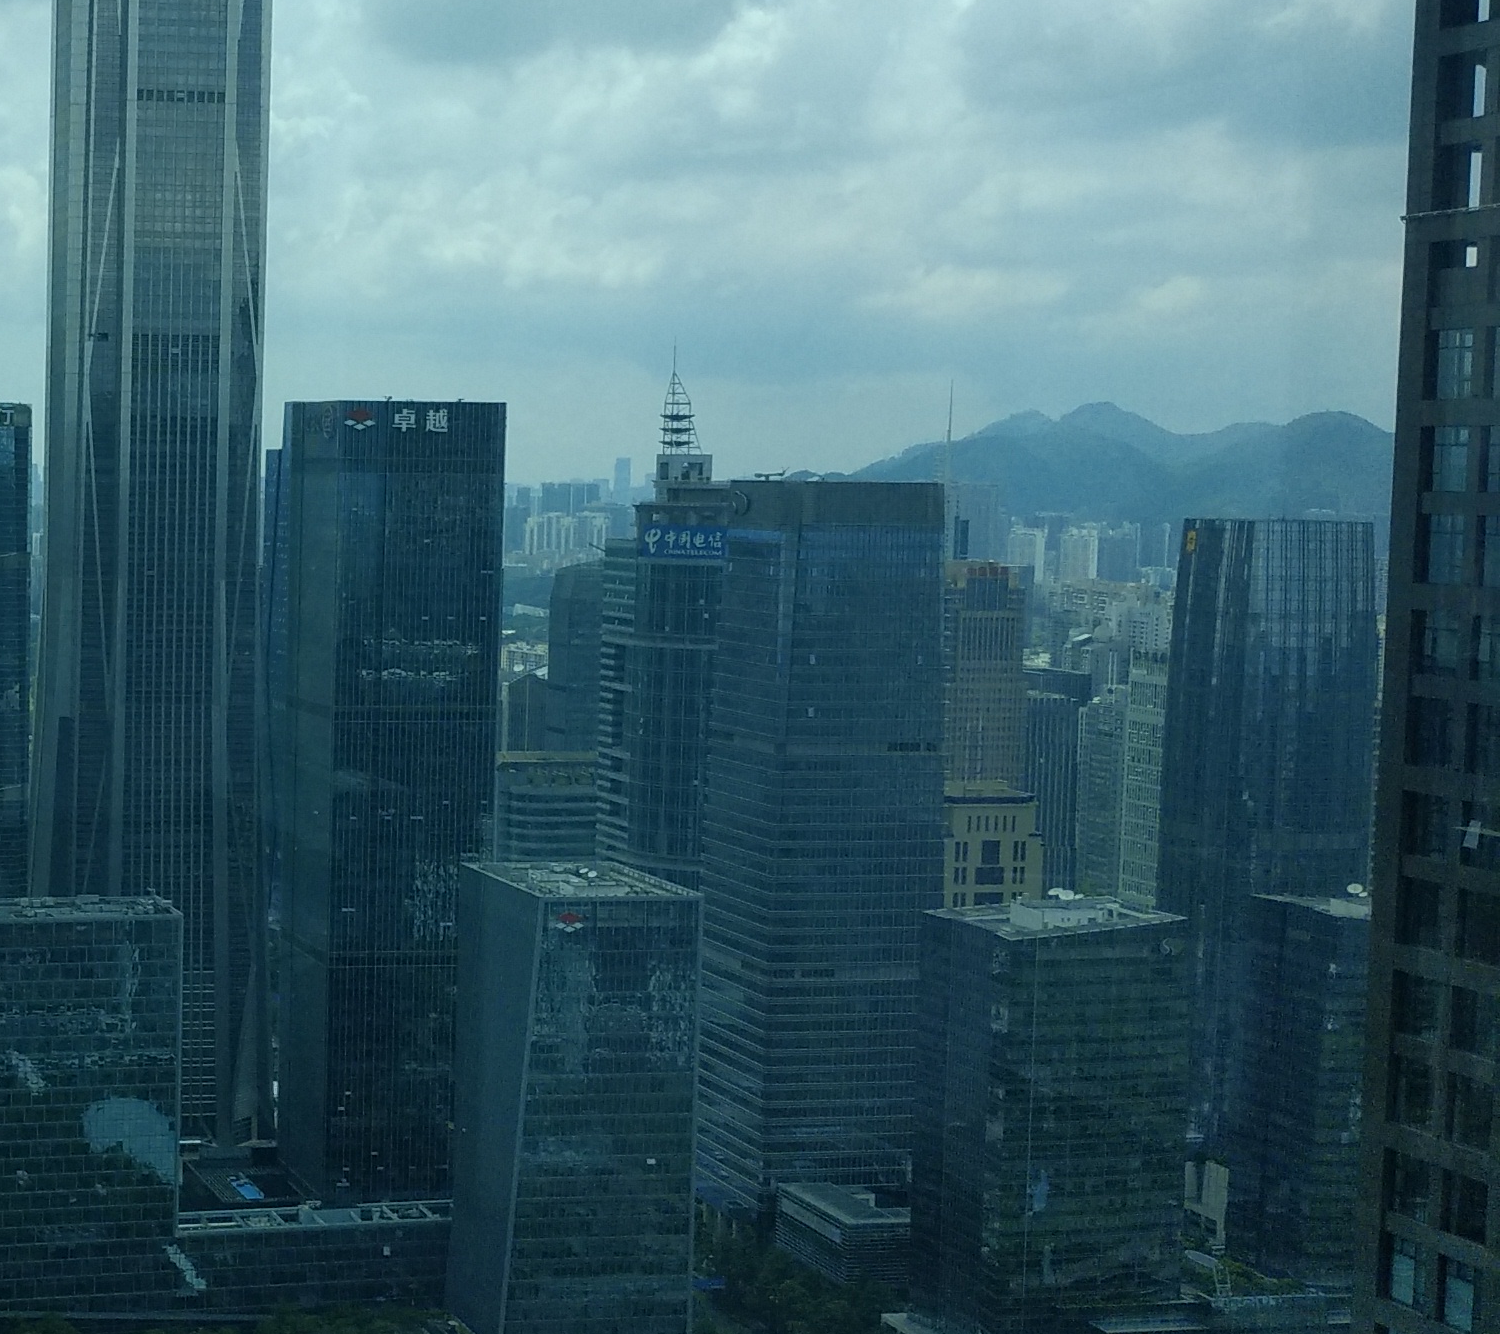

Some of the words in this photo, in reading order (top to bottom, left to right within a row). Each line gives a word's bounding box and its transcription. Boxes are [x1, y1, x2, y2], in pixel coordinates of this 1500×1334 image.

[392, 408, 448, 433] 卓越
[664, 530, 722, 549] 中国电信
